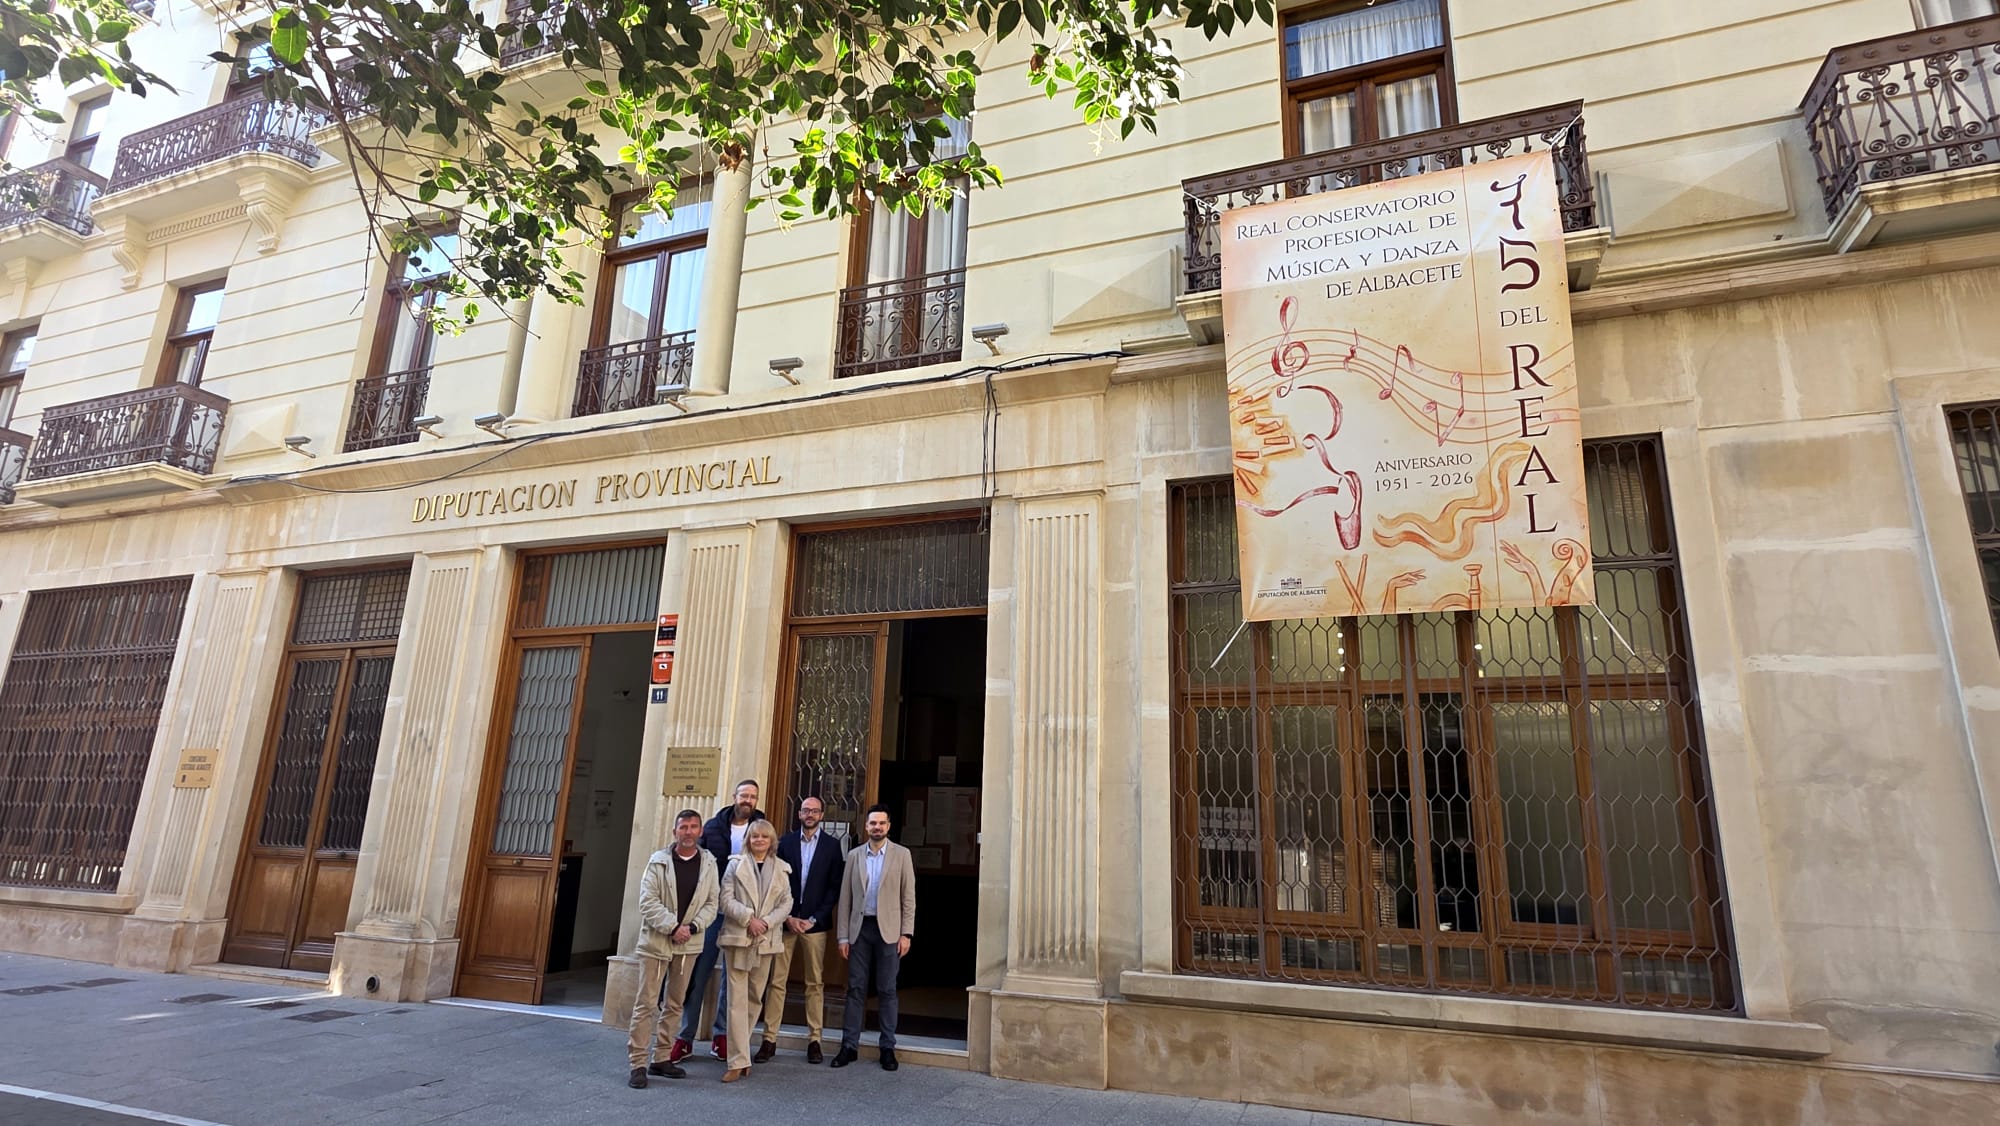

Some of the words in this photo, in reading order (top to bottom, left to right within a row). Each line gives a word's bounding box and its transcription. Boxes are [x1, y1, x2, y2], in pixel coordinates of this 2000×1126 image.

[1237, 221, 1282, 240] REAL
[1287, 189, 1455, 231] CONSERVATORIO
[1285, 220, 1419, 254] PROFESIONAL
[1429, 212, 1457, 229] DE
[1267, 256, 1350, 282] MÚSICA
[1359, 253, 1372, 266] Y
[1383, 239, 1460, 263] DANZA
[1326, 281, 1353, 299] DE
[1357, 263, 1463, 294] ALBACETE
[1500, 306, 1549, 328] DEL
[1506, 343, 1560, 534] REAL
[1374, 453, 1473, 473] ANIVERSARIO
[1376, 477, 1408, 492] 1951
[1430, 471, 1473, 487] 2026
[411, 479, 577, 523] DIPUTACION
[595, 455, 782, 504] PROVINCIAL
[1299, 588, 1328, 596] ALBACETE
